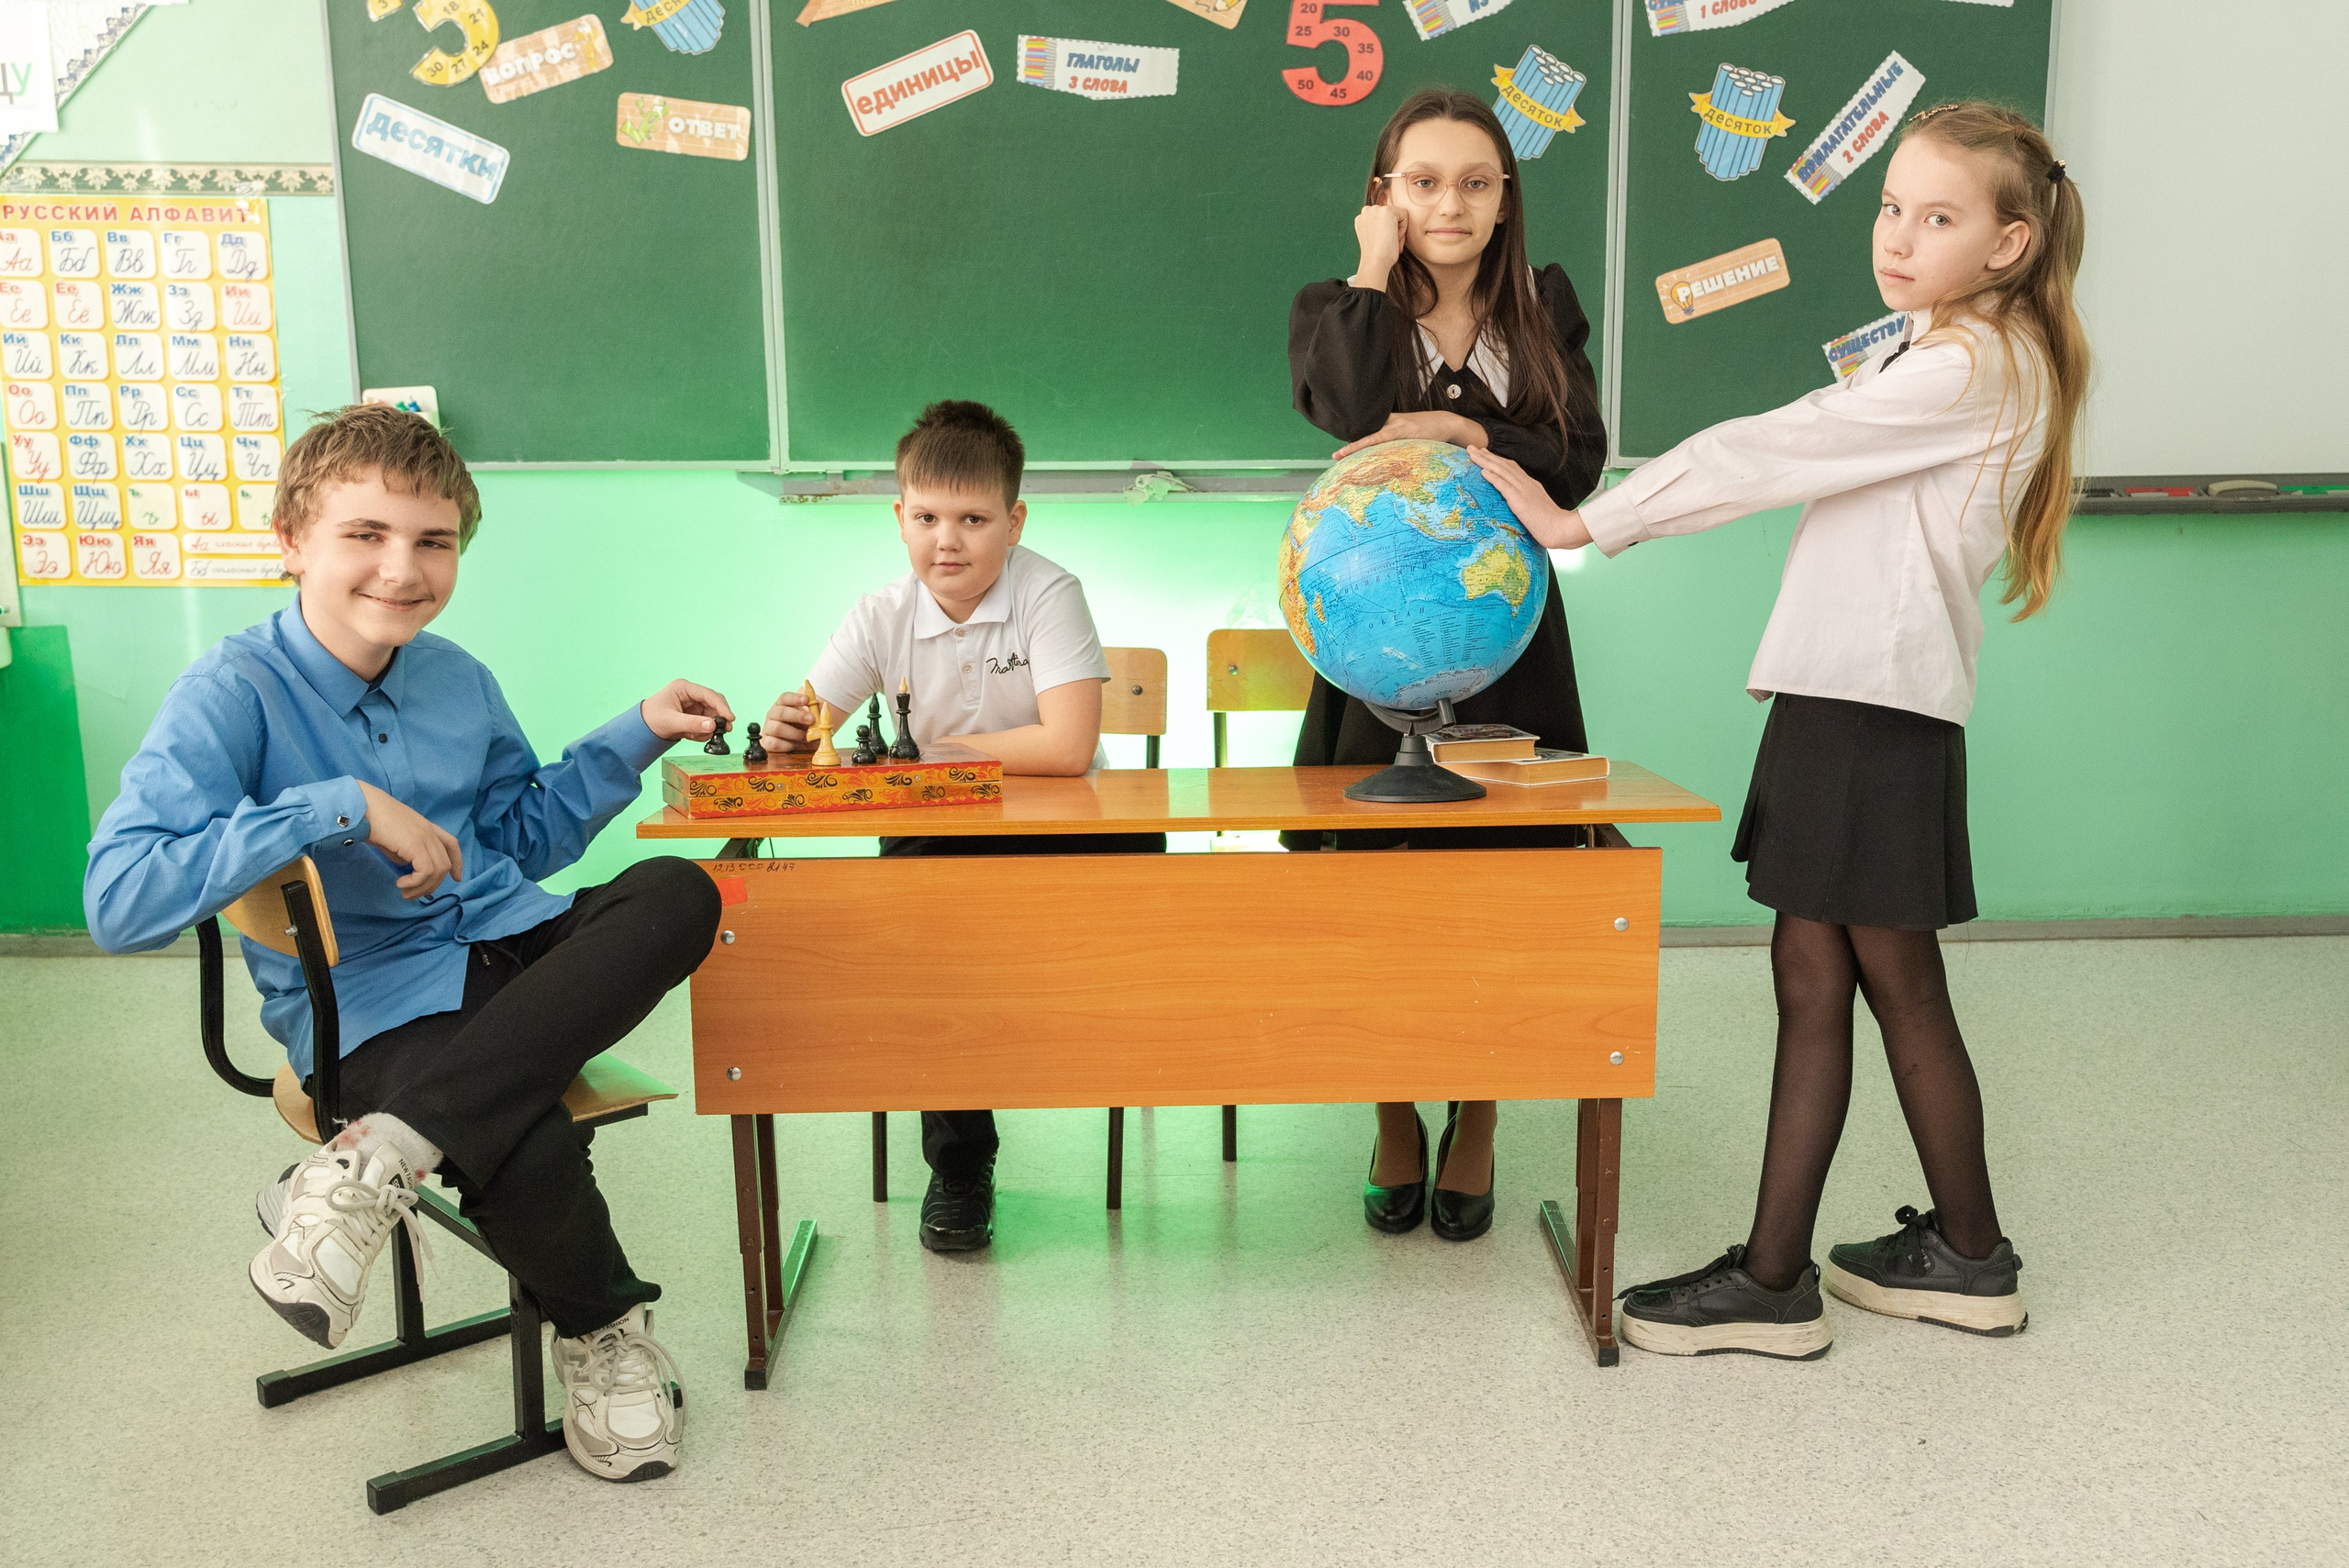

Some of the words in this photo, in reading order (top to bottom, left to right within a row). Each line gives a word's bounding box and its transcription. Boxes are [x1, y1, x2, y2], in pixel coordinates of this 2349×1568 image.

[443, 1, 459, 15] 18
[469, 8, 484, 24] 21
[1300, 4, 1317, 14] 20
[1700, 5, 1706, 18] 1
[1295, 26, 1311, 36] 25
[1333, 27, 1350, 37] 30
[473, 40, 489, 56] 24
[1358, 43, 1374, 53] 35
[427, 61, 443, 77] 30
[451, 59, 466, 73] 27
[1066, 52, 1140, 72] ГЛАГОЛЫ
[856, 50, 981, 115] единицы
[1068, 75, 1078, 89] 3
[1082, 77, 1128, 93] СЛОВА
[1356, 71, 1373, 81] 40
[1297, 80, 1314, 90] 50
[1330, 88, 1347, 99] 45
[668, 117, 740, 139] ОТВЕТ
[1797, 61, 1903, 183] ПРИЛАГАТЕЛЬНЫЕ
[1842, 150, 1854, 163] 2
[1852, 111, 1889, 152] СЛОВА
[3, 203, 117, 220] РУССКИЙ
[130, 206, 250, 222] АЛФАВИТ
[1676, 255, 1779, 303] РЕШЕНИЕ
